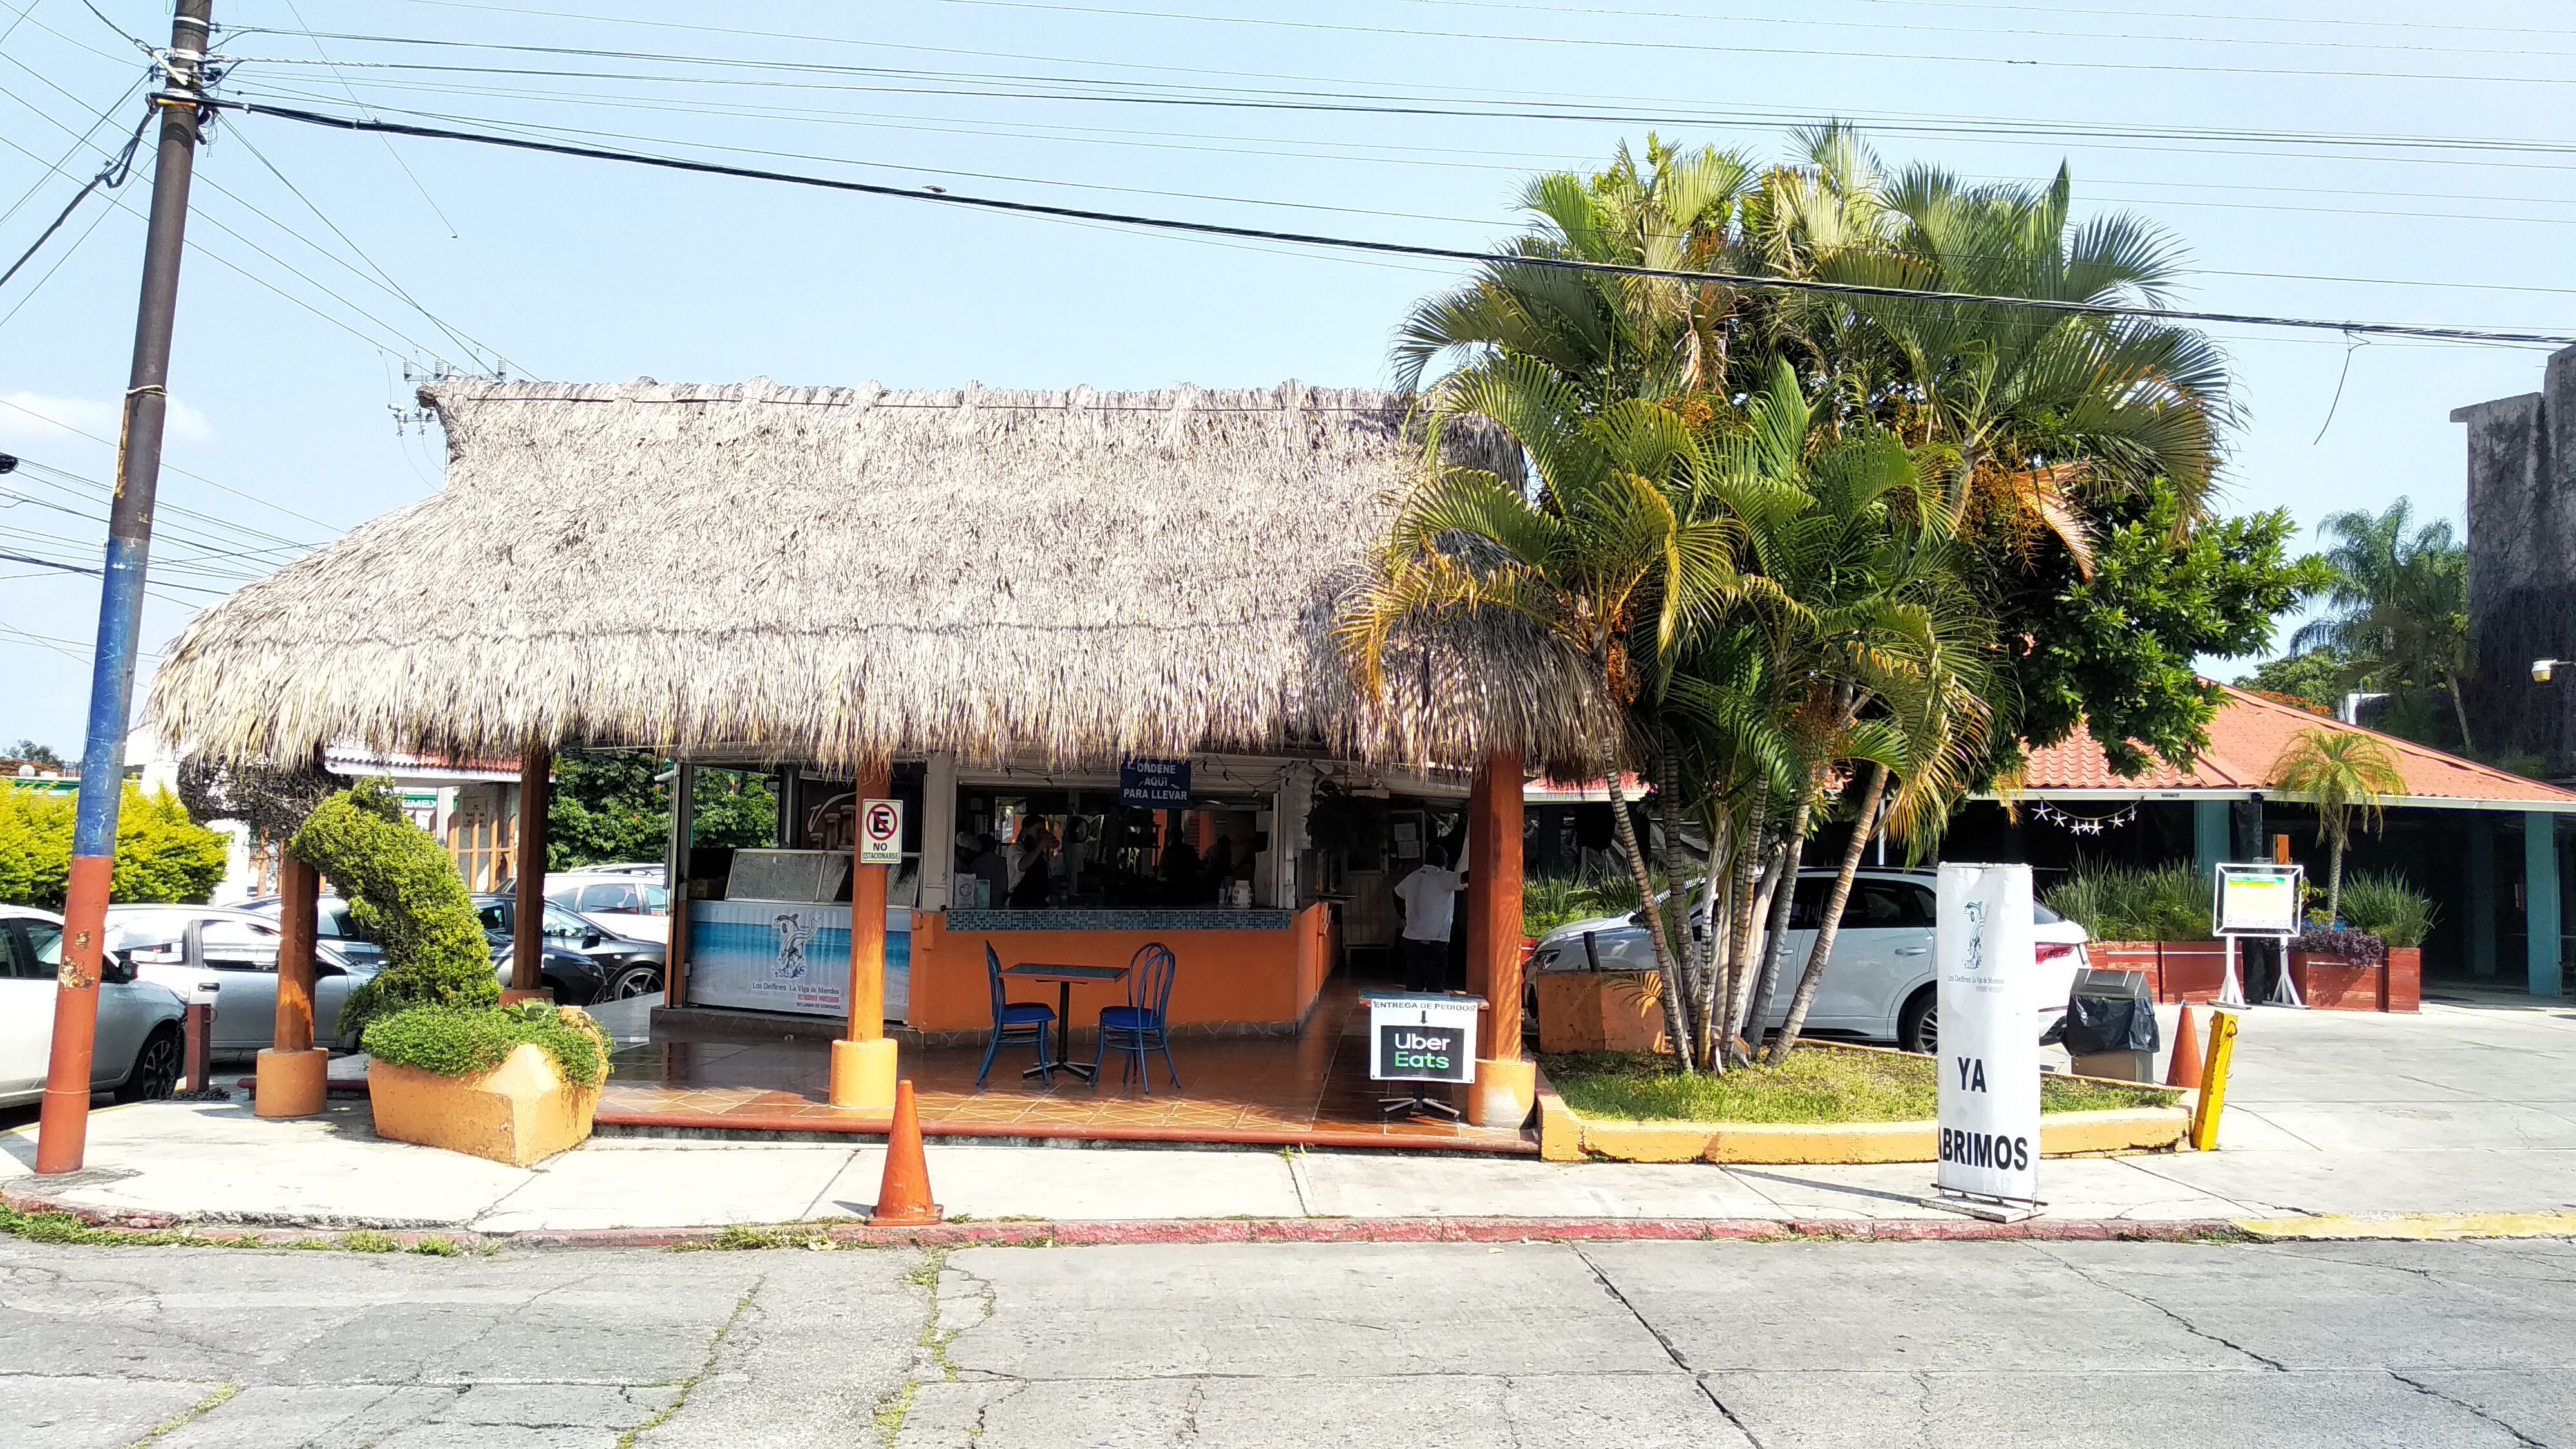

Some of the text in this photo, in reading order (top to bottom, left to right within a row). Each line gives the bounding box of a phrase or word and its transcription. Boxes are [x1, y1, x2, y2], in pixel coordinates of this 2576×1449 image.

[1137, 763, 1176, 774] ORDENE
[1123, 788, 1188, 800] PARA LLEVAR
[401, 799, 437, 808] EMEX
[2227, 915, 2289, 927] Bienvenidos
[764, 982, 786, 990] Delfines
[798, 985, 810, 994] Viga
[1395, 1033, 1450, 1050] Uber
[1395, 1052, 1450, 1069] Eats
[1957, 1057, 1987, 1093] YA
